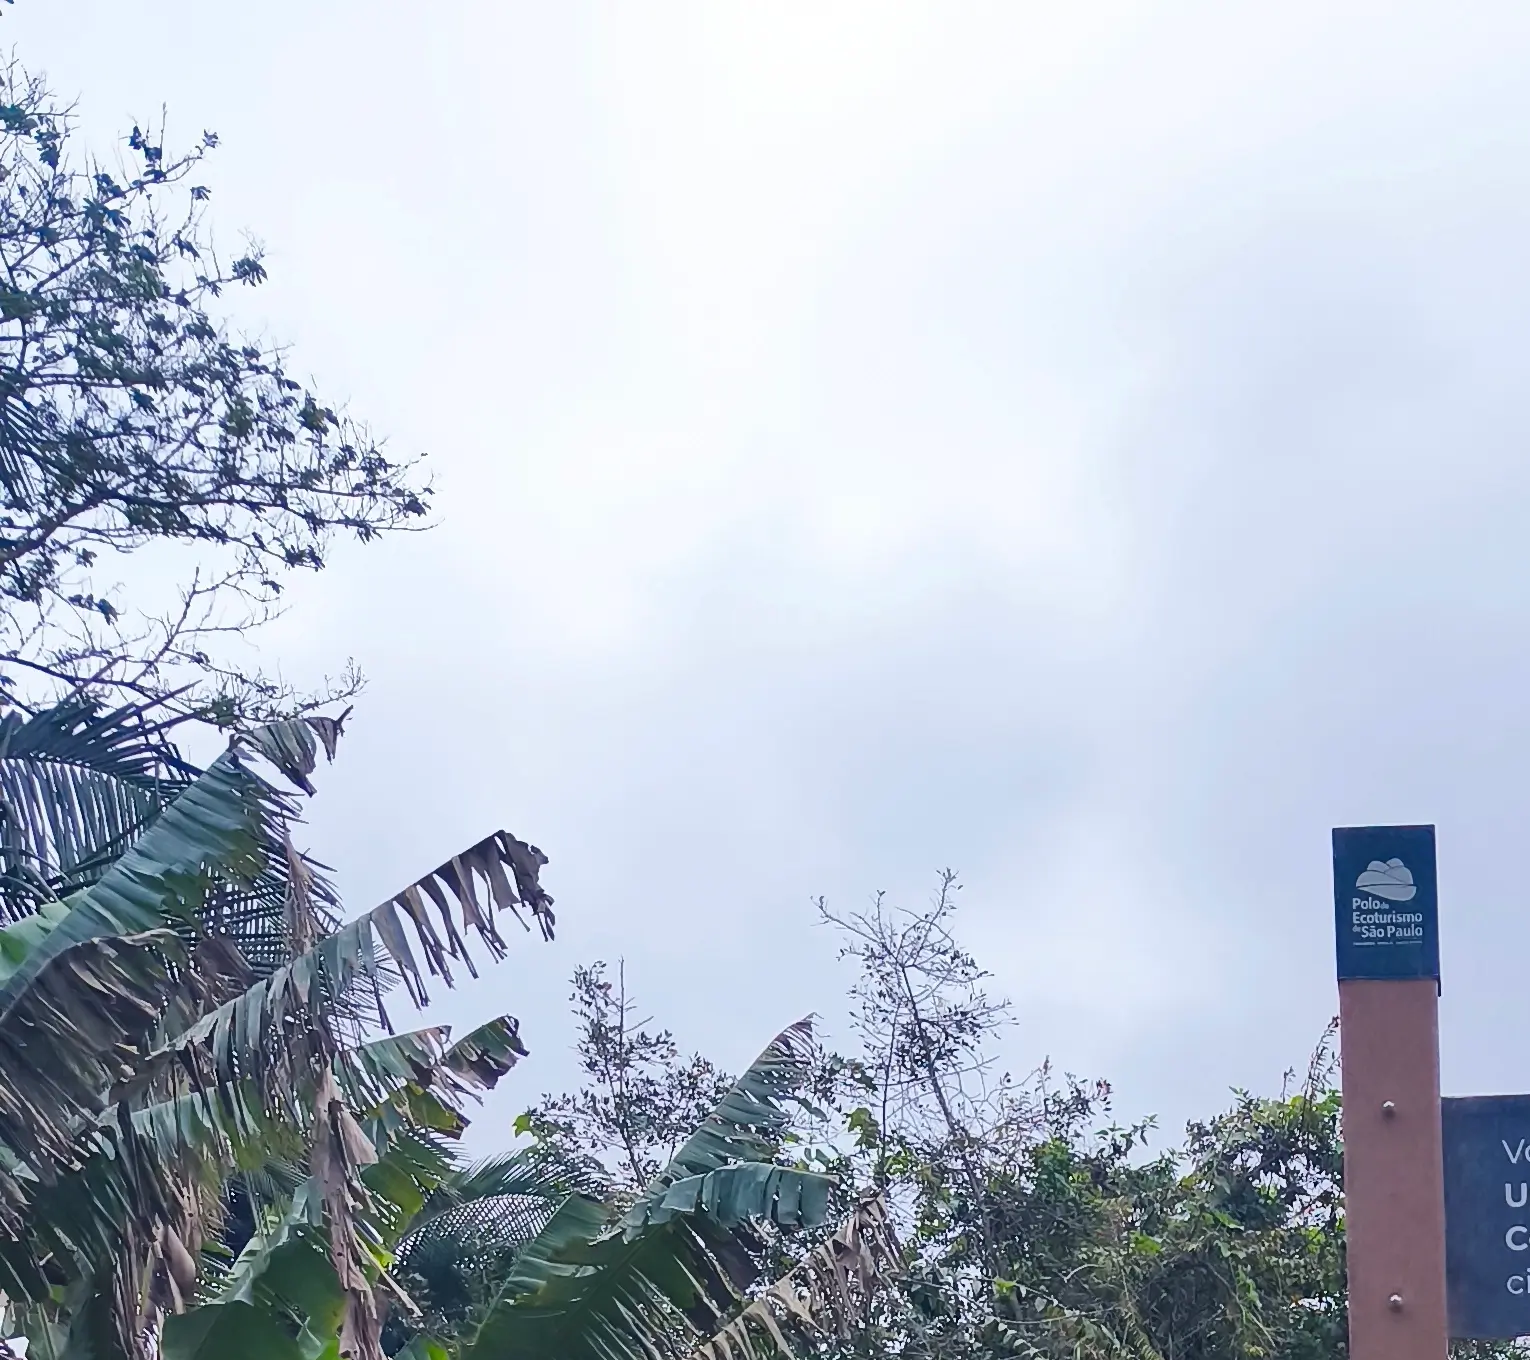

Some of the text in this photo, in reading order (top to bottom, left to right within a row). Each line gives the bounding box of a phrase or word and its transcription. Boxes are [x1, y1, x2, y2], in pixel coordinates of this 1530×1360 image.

[1352, 897, 1380, 910] Polo
[1352, 911, 1423, 924] Ecoturismo
[1361, 925, 1385, 938] São
[1386, 924, 1423, 938] Paulo
